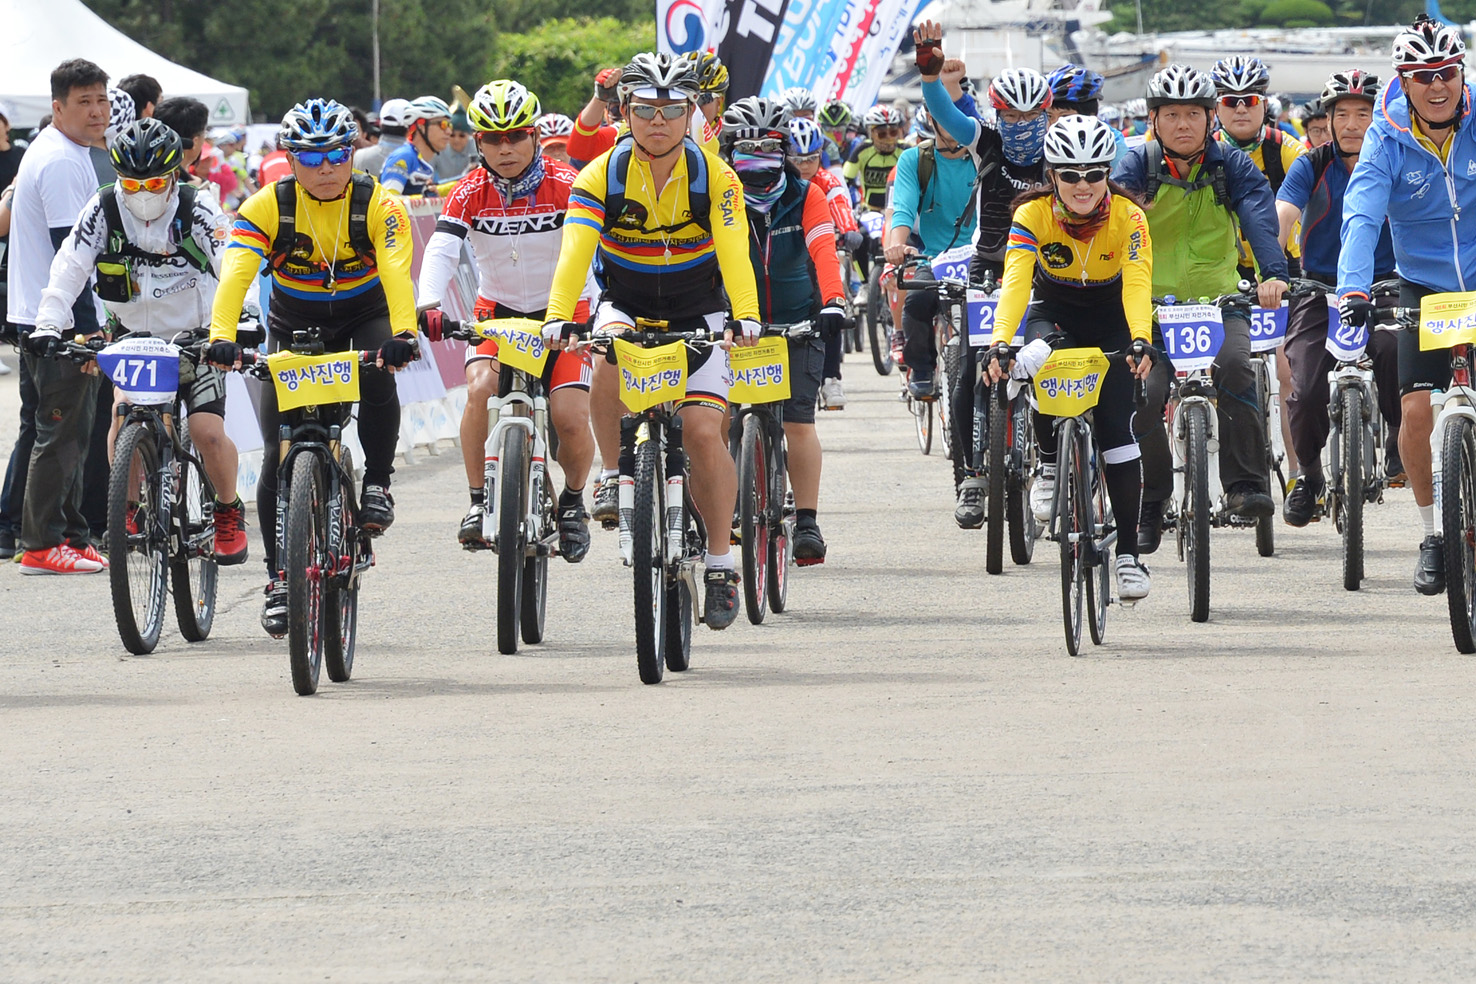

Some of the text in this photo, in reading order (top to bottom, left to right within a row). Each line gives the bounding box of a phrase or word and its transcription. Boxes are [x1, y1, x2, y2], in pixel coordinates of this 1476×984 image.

[1169, 312, 1190, 320] 부산시민
[1165, 325, 1211, 355] 136
[112, 358, 158, 387] 471
[277, 360, 351, 391] 행사진행
[622, 368, 682, 393] 행사진행
[1040, 372, 1099, 398] 행사진행
